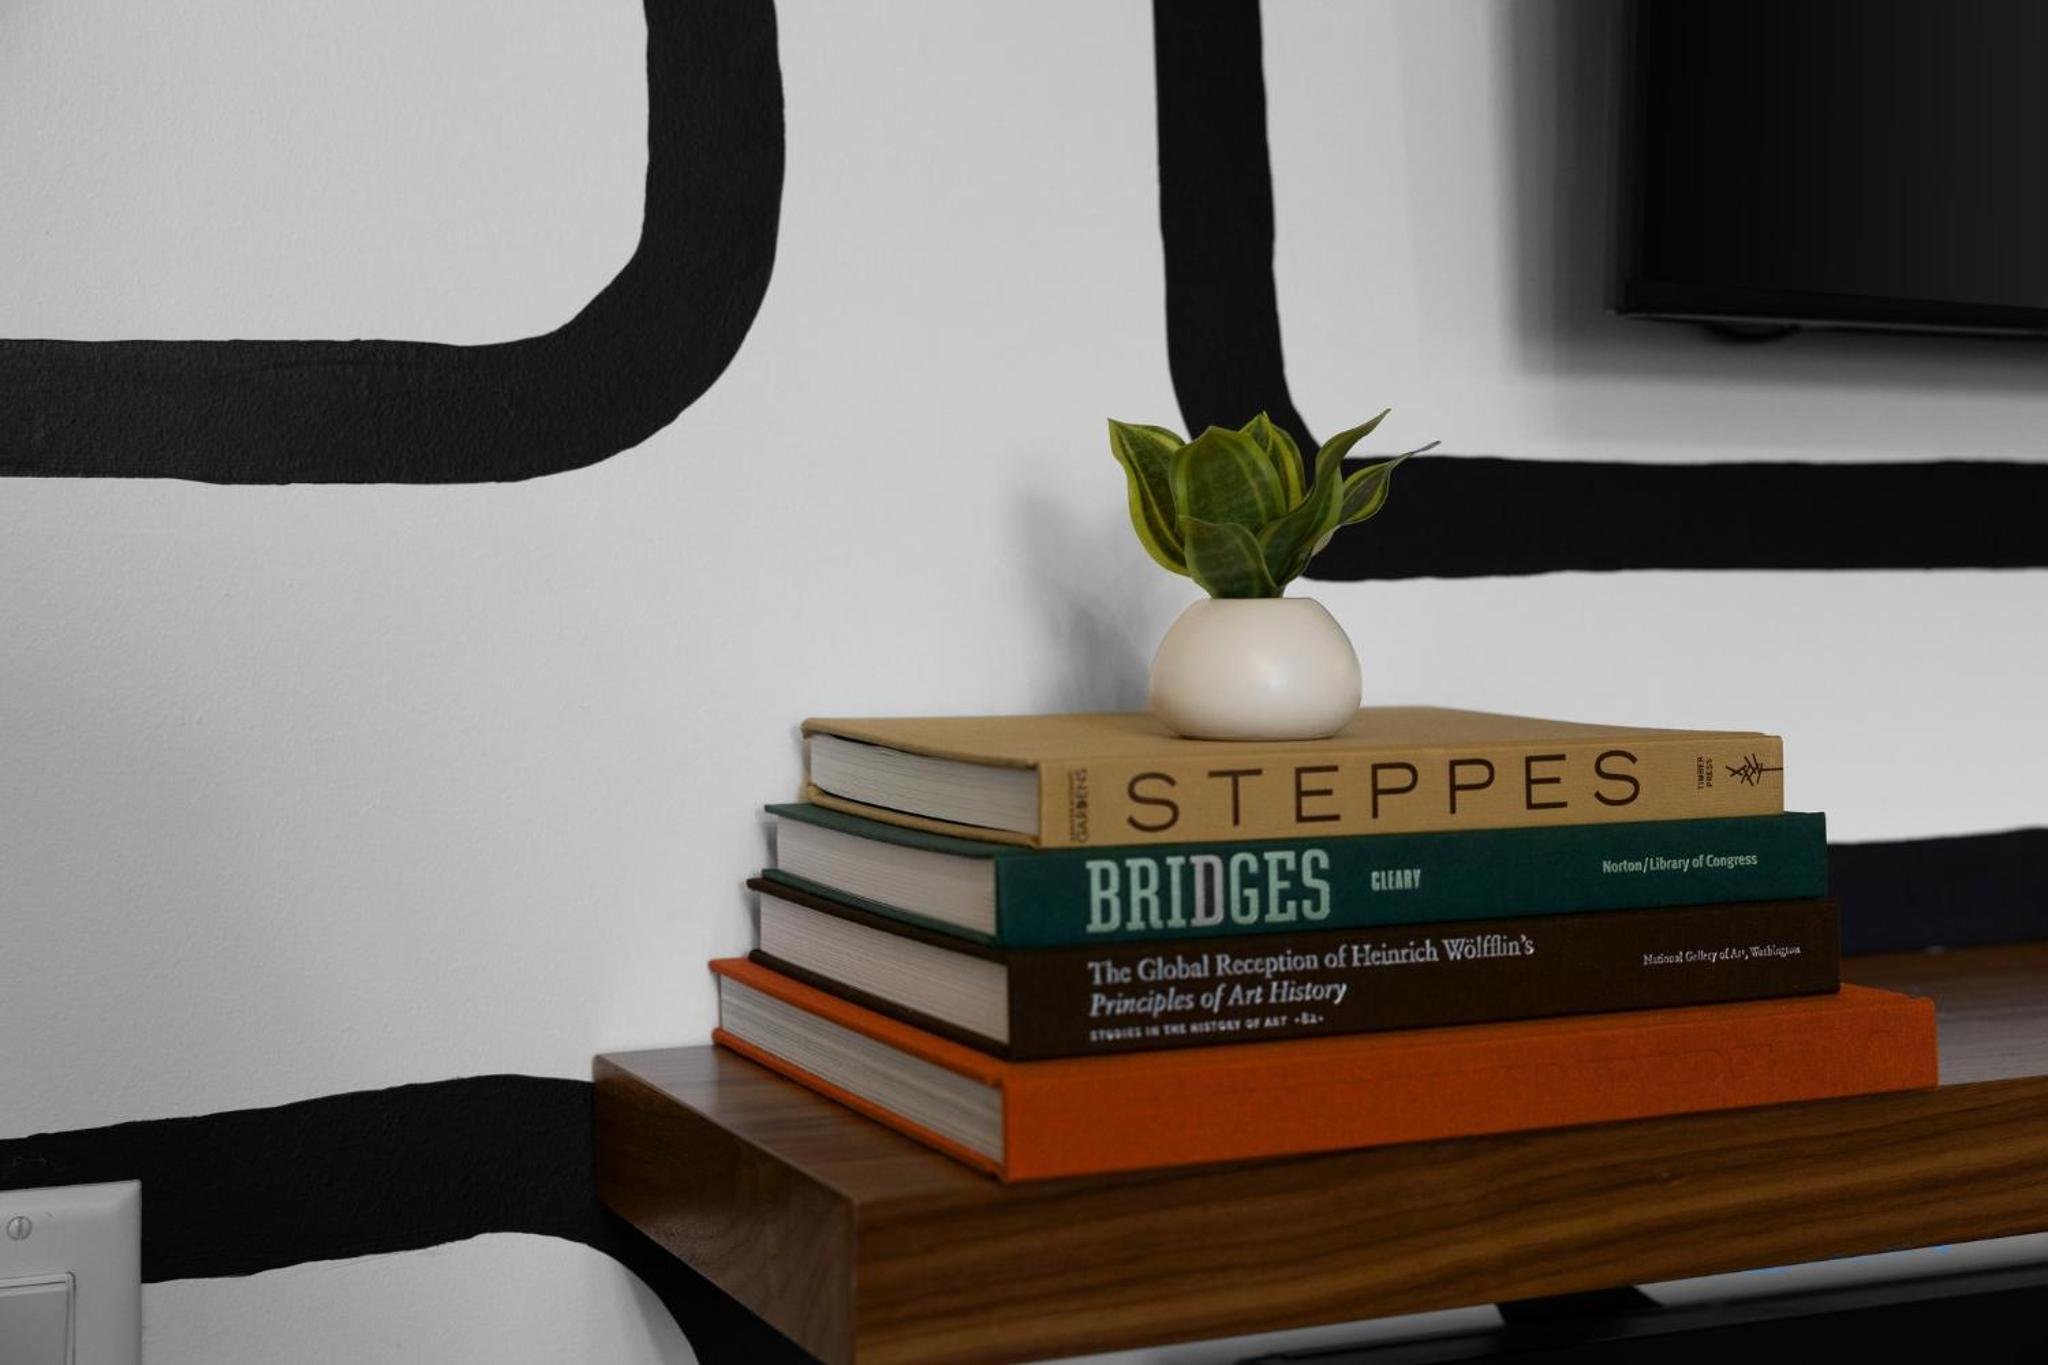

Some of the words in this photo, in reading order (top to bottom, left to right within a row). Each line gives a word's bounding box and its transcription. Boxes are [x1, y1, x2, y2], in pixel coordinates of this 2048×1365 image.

[1705, 758, 1713, 787] PRESS
[1126, 749, 1641, 834] STEPPES
[1692, 855, 1704, 868] of
[1706, 853, 1758, 868] Congress
[1085, 848, 1331, 934] BRIDGES
[1371, 869, 1421, 891] CLEARY
[1088, 959, 1132, 986] The
[1137, 953, 1210, 982] Global
[1216, 949, 1319, 978] Reception
[1324, 944, 1348, 969] of
[1351, 938, 1440, 967] Heinrich
[1643, 951, 1683, 966] National
[1685, 950, 1717, 963] Gallery
[1719, 947, 1730, 960] of
[1730, 946, 1749, 960] Art,
[1749, 944, 1801, 959] Washington
[1090, 986, 1195, 1018] Principles
[1200, 982, 1227, 1014] of
[1227, 984, 1264, 1006] Art
[1269, 979, 1347, 1006] History
[1090, 1027, 1142, 1041] STUDIES
[1145, 1025, 1160, 1037] IN
[1164, 1022, 1187, 1035] THE
[1190, 1020, 1241, 1033] HISTORY
[1246, 1018, 1261, 1029] OF
[1264, 1015, 1288, 1028] ART
